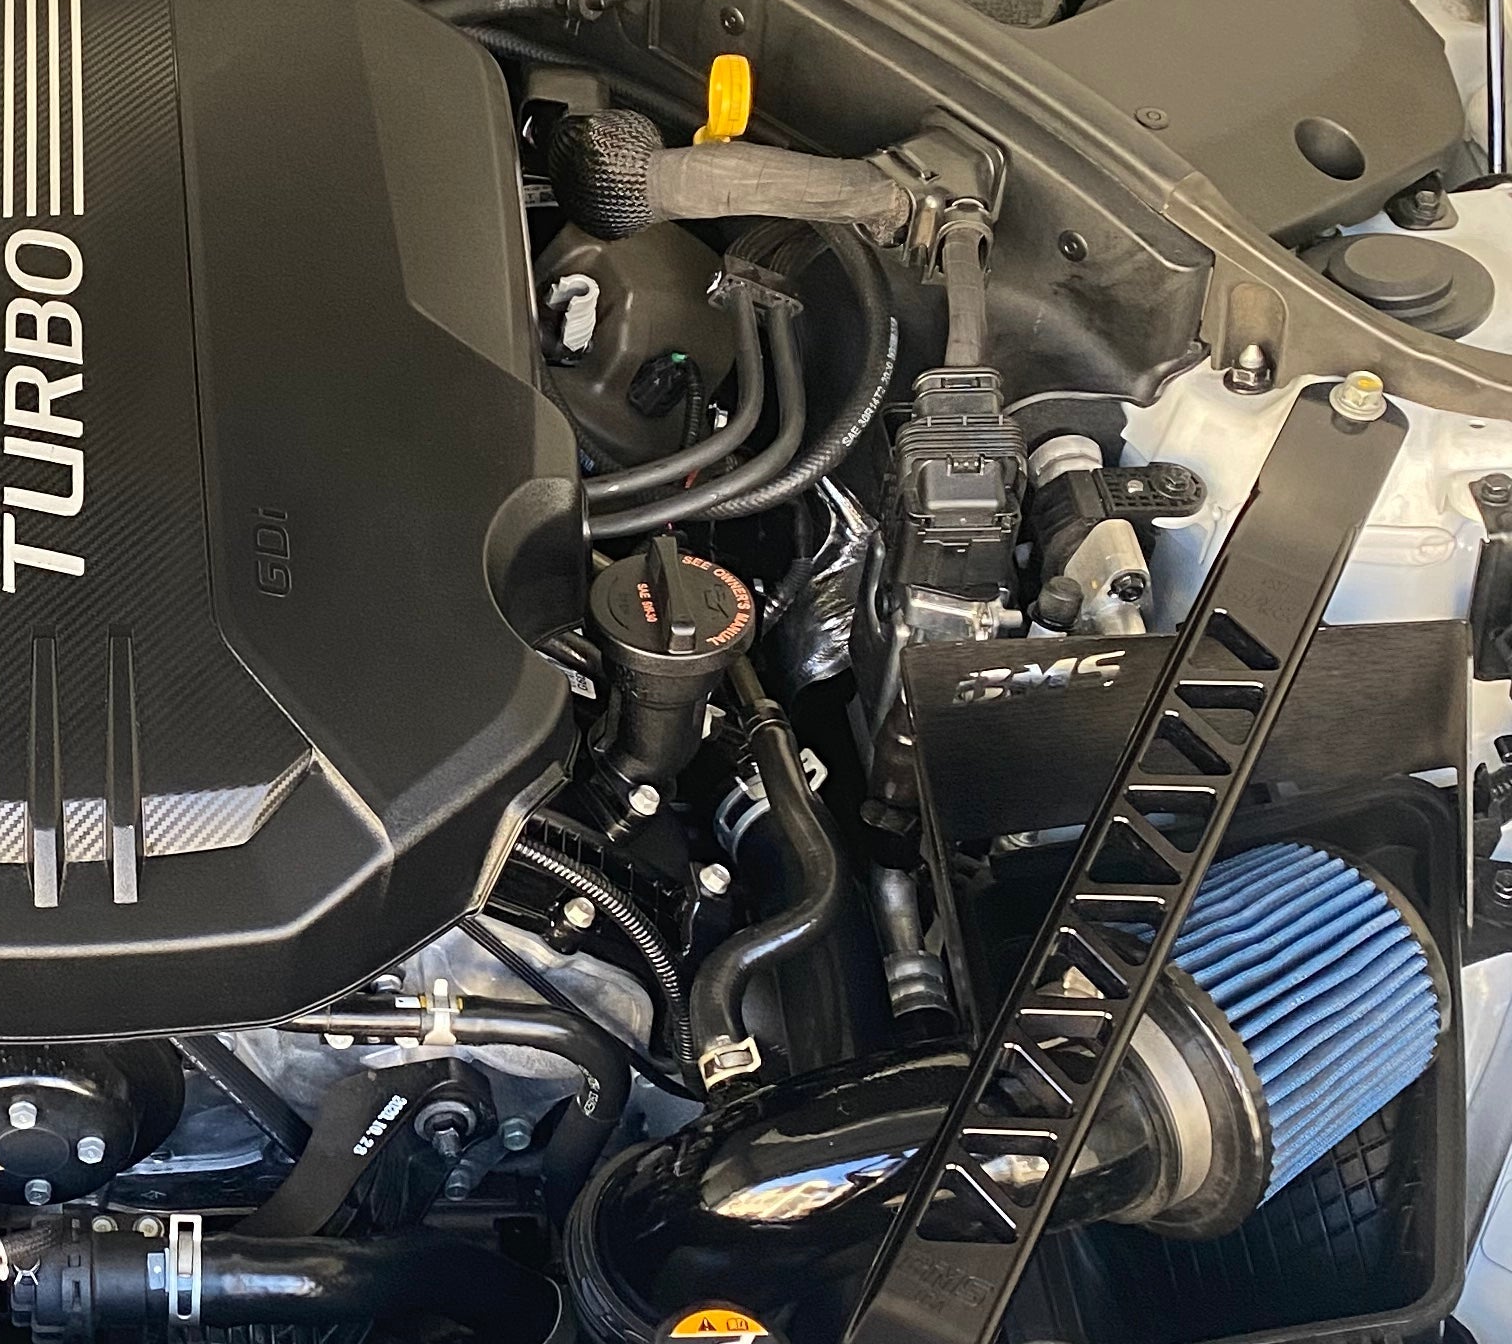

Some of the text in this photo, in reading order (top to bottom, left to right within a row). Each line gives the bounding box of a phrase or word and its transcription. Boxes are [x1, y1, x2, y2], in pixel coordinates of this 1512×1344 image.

[2, 228, 85, 594] TURBO
[842, 425, 862, 447] SAE
[256, 507, 292, 597] GDi
[637, 583, 651, 599] SAE
[682, 556, 751, 646] SEE OWNER'S MANUAL
[952, 650, 1126, 704] BMS
